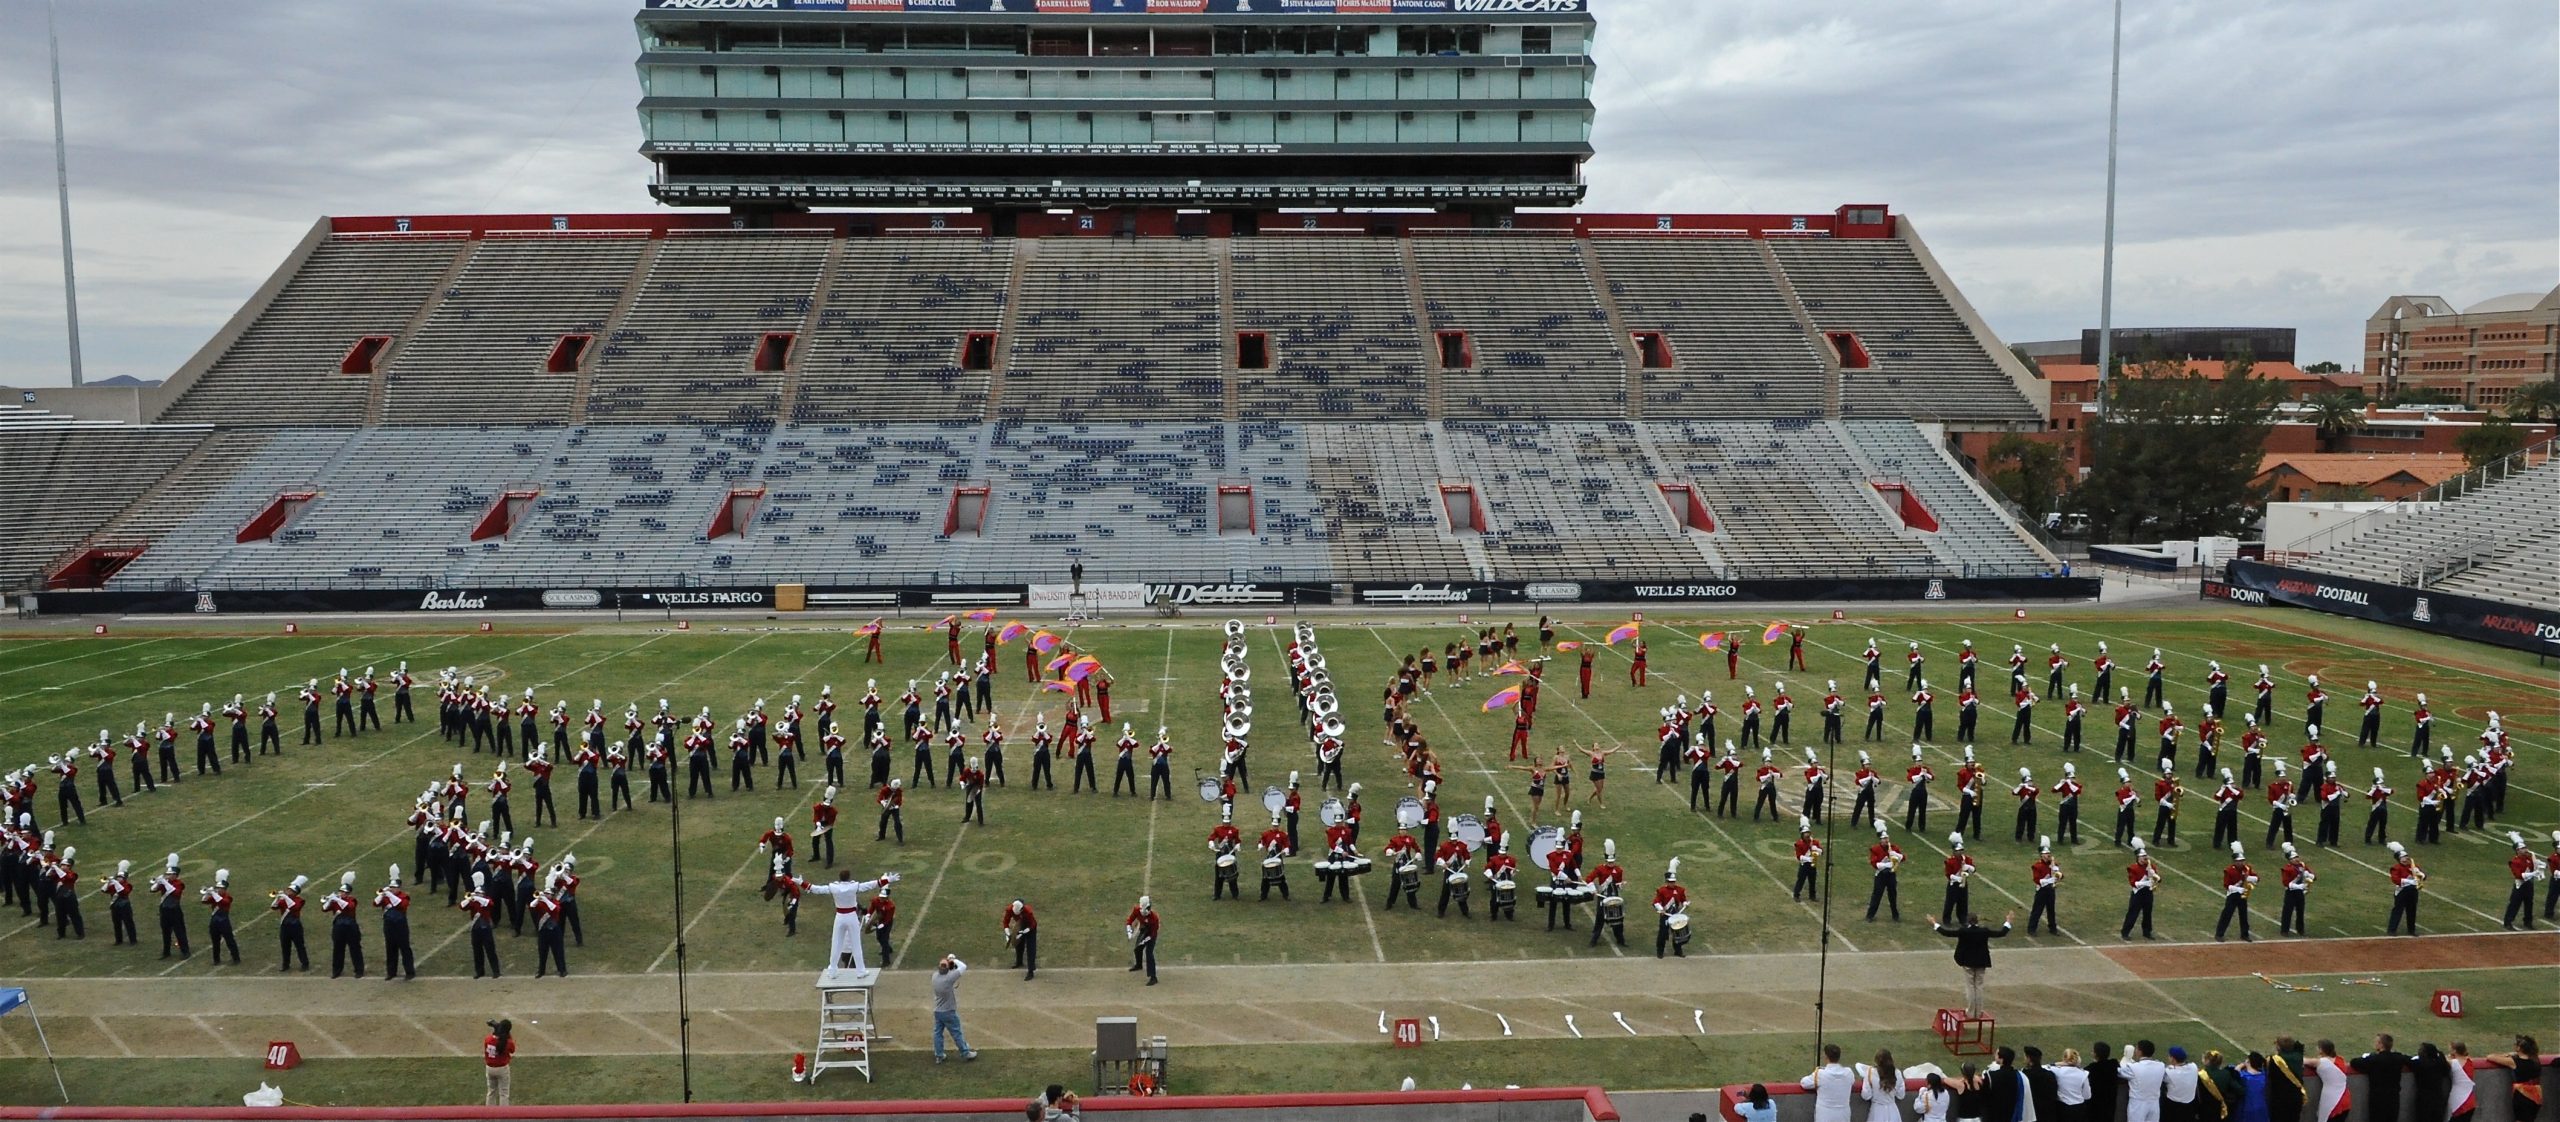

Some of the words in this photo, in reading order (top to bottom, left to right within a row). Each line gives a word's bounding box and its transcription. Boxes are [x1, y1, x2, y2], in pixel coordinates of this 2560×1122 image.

[1424, 0, 1446, 8] CASON
[1454, 0, 1580, 11] WILDCATS
[397, 223, 409, 232] 17
[555, 221, 567, 231] 18
[1081, 219, 1092, 229] 21
[1658, 219, 1671, 230] 24
[1792, 221, 1806, 231] 25
[24, 393, 35, 402] 16
[1032, 591, 1067, 601] UNIVERSITY
[1108, 590, 1127, 600] BAND
[1128, 590, 1142, 600] DAY
[1634, 586, 1686, 596] WELLS
[1688, 585, 1737, 596] FARGO
[419, 591, 488, 609] Bashas'
[656, 593, 709, 603] WELLS
[711, 593, 763, 603] FARGO
[2440, 995, 2460, 1014] 20
[1398, 1023, 1417, 1042] 40
[846, 1035, 861, 1050] 50
[268, 1046, 287, 1066] 40
